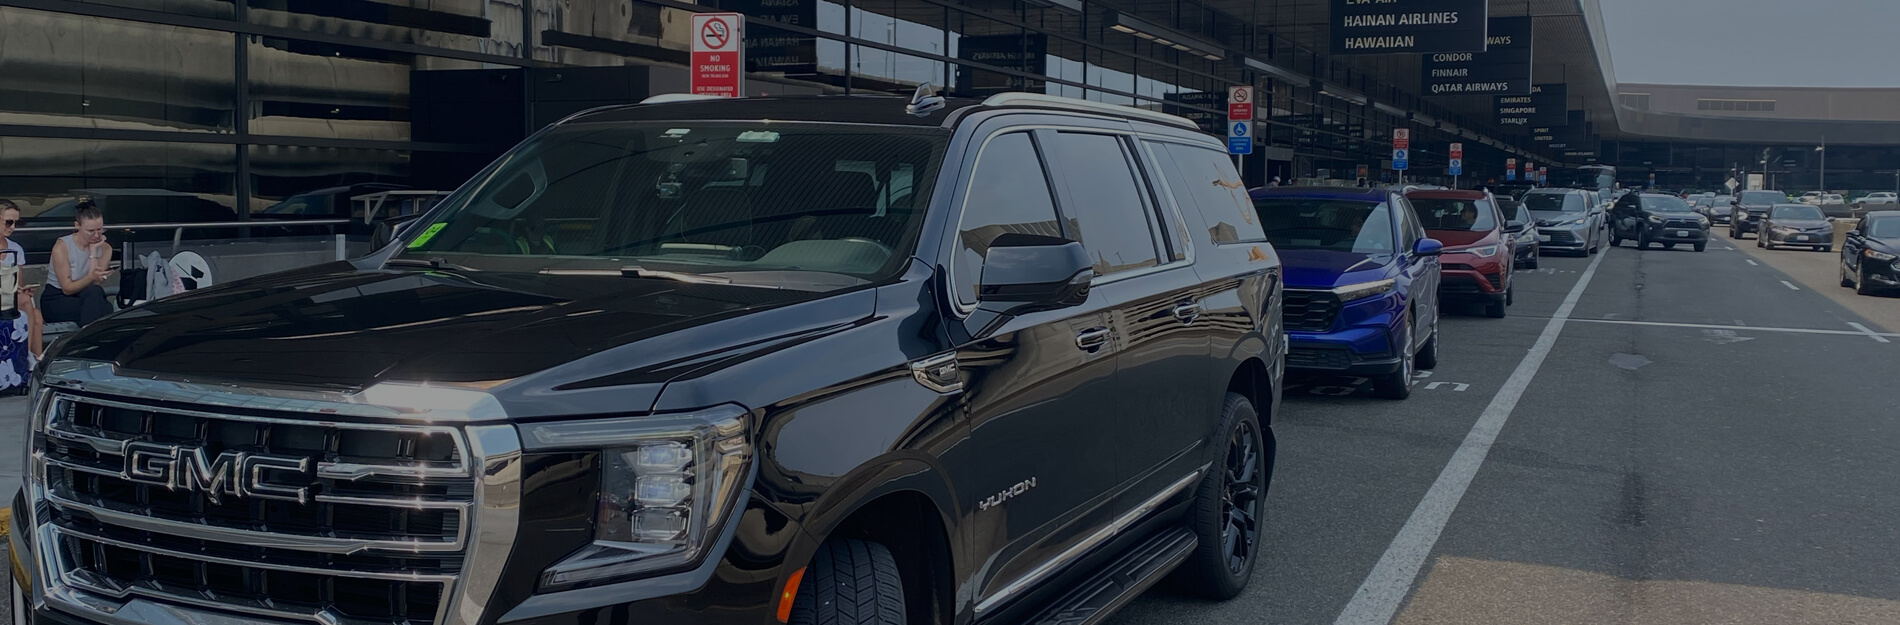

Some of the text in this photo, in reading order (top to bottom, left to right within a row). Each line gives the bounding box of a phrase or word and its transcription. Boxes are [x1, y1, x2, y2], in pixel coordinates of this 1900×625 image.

[1344, 11, 1459, 27] HAINAN AIRLINES
[1345, 35, 1415, 49] HAWAIIAN
[1433, 53, 1473, 62] CONDOR
[700, 64, 731, 72] SMOKING
[1431, 68, 1469, 77] FINNAIR
[1431, 82, 1509, 94] QATAR AIRWAYS
[940, 363, 956, 375] GMC
[124, 440, 311, 506] GMC
[979, 476, 1037, 511] YUKON
